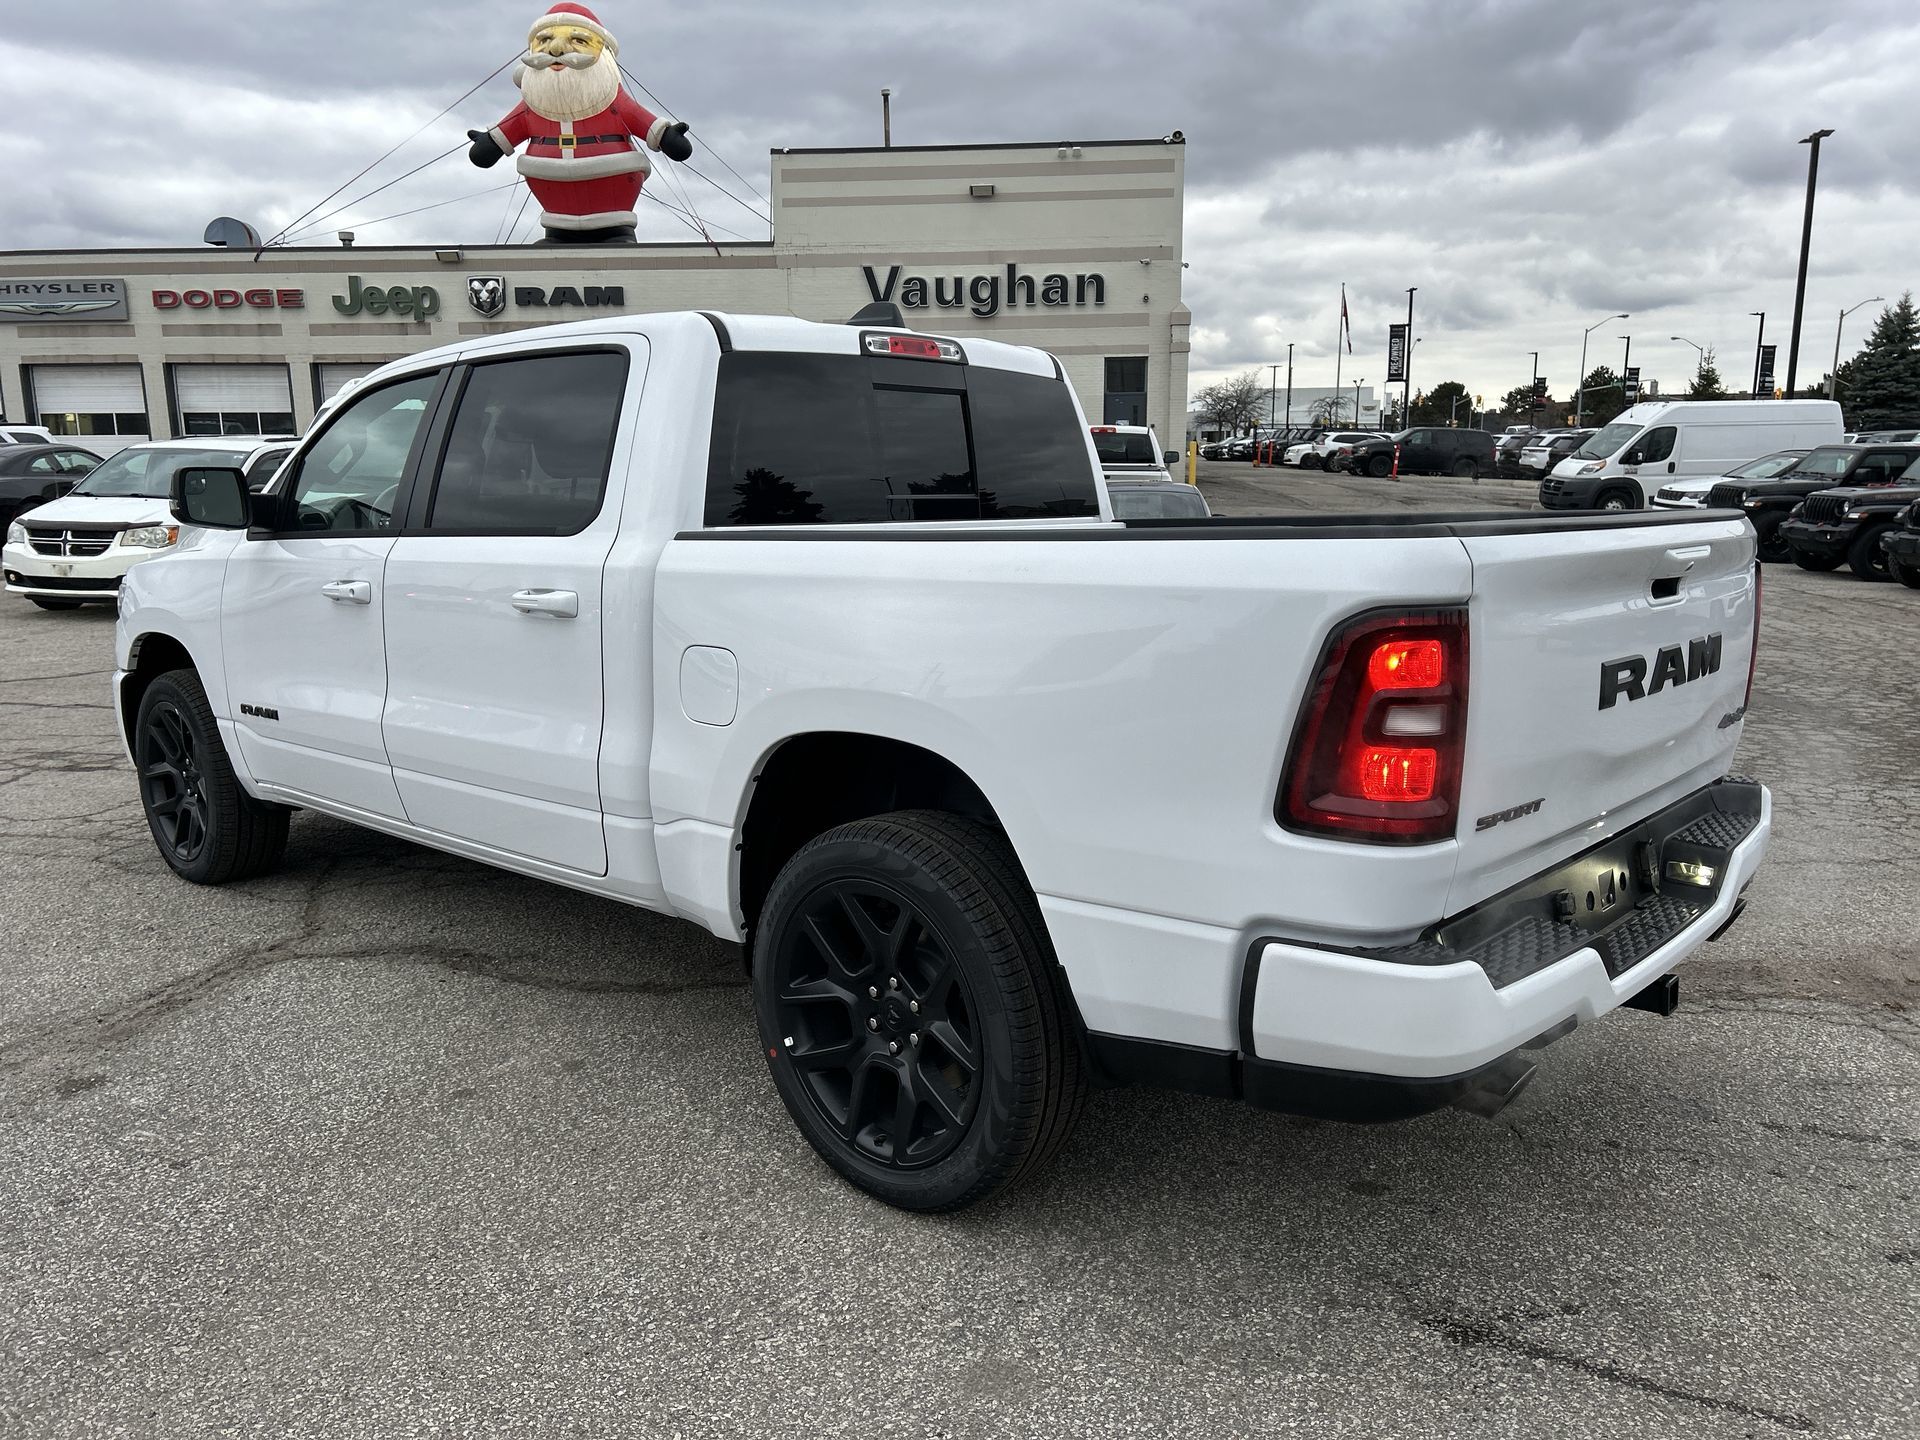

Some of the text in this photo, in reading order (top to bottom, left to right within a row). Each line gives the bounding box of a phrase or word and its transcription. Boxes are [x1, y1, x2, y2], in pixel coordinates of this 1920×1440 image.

[0, 283, 116, 294] HRYSLER
[152, 289, 305, 309] DODGE
[332, 275, 440, 321] Jeep
[514, 286, 625, 307] RAM
[863, 263, 1105, 318] Vaughan
[1599, 631, 1722, 711] RAM
[240, 703, 279, 720] RAM
[1475, 797, 1546, 832] SPORT
